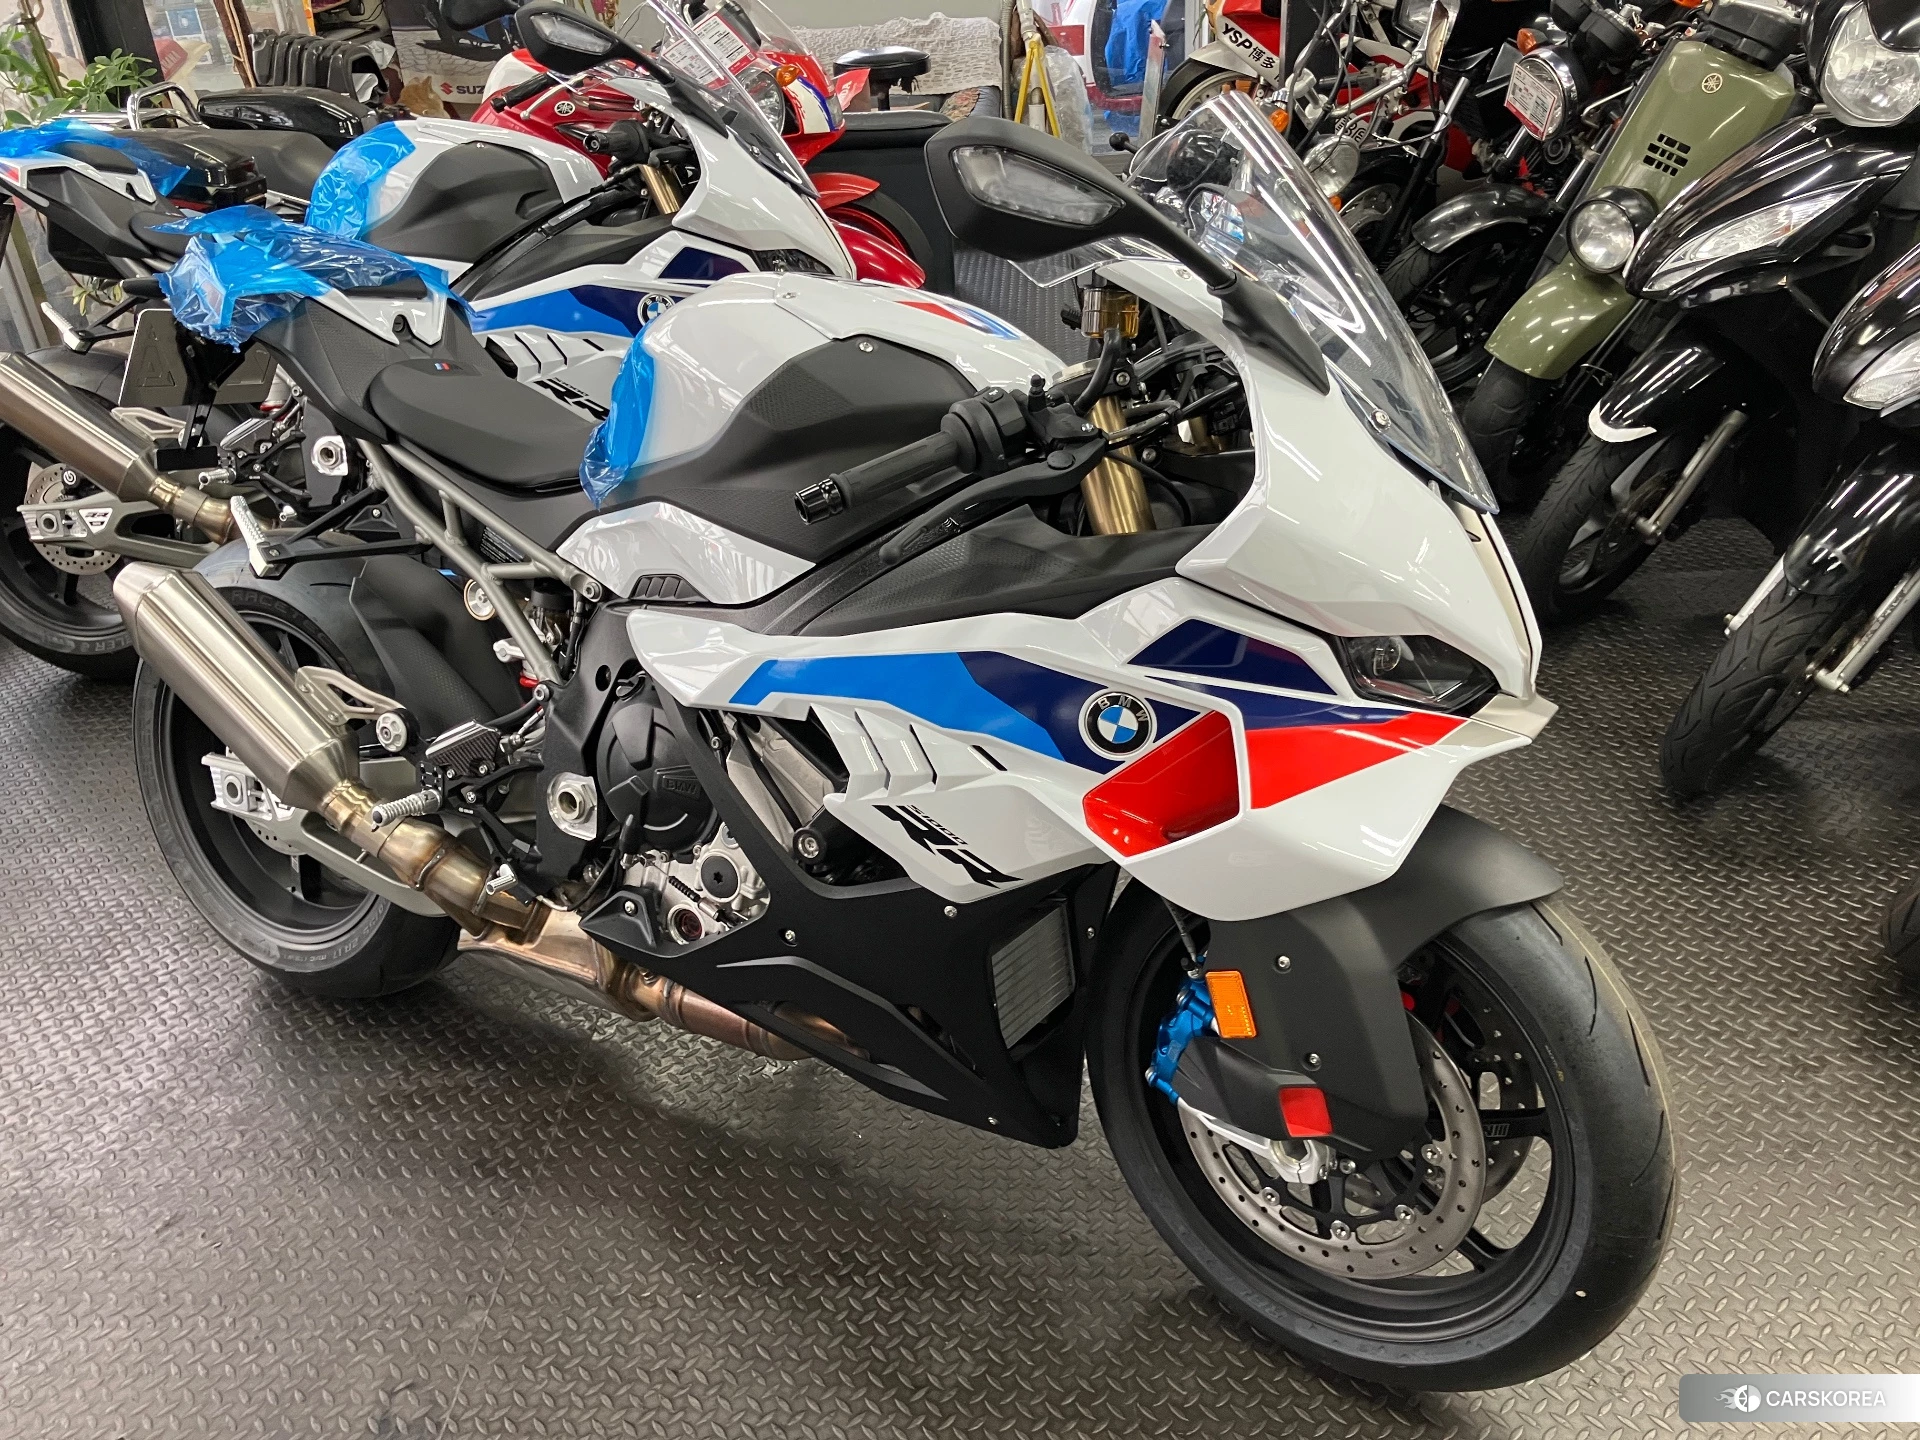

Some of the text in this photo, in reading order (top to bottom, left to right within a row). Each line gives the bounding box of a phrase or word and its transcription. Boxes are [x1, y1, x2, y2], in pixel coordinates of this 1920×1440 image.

[1097, 694, 1149, 722] BMW
[907, 804, 969, 845] S1000
[871, 804, 1025, 889] RR
